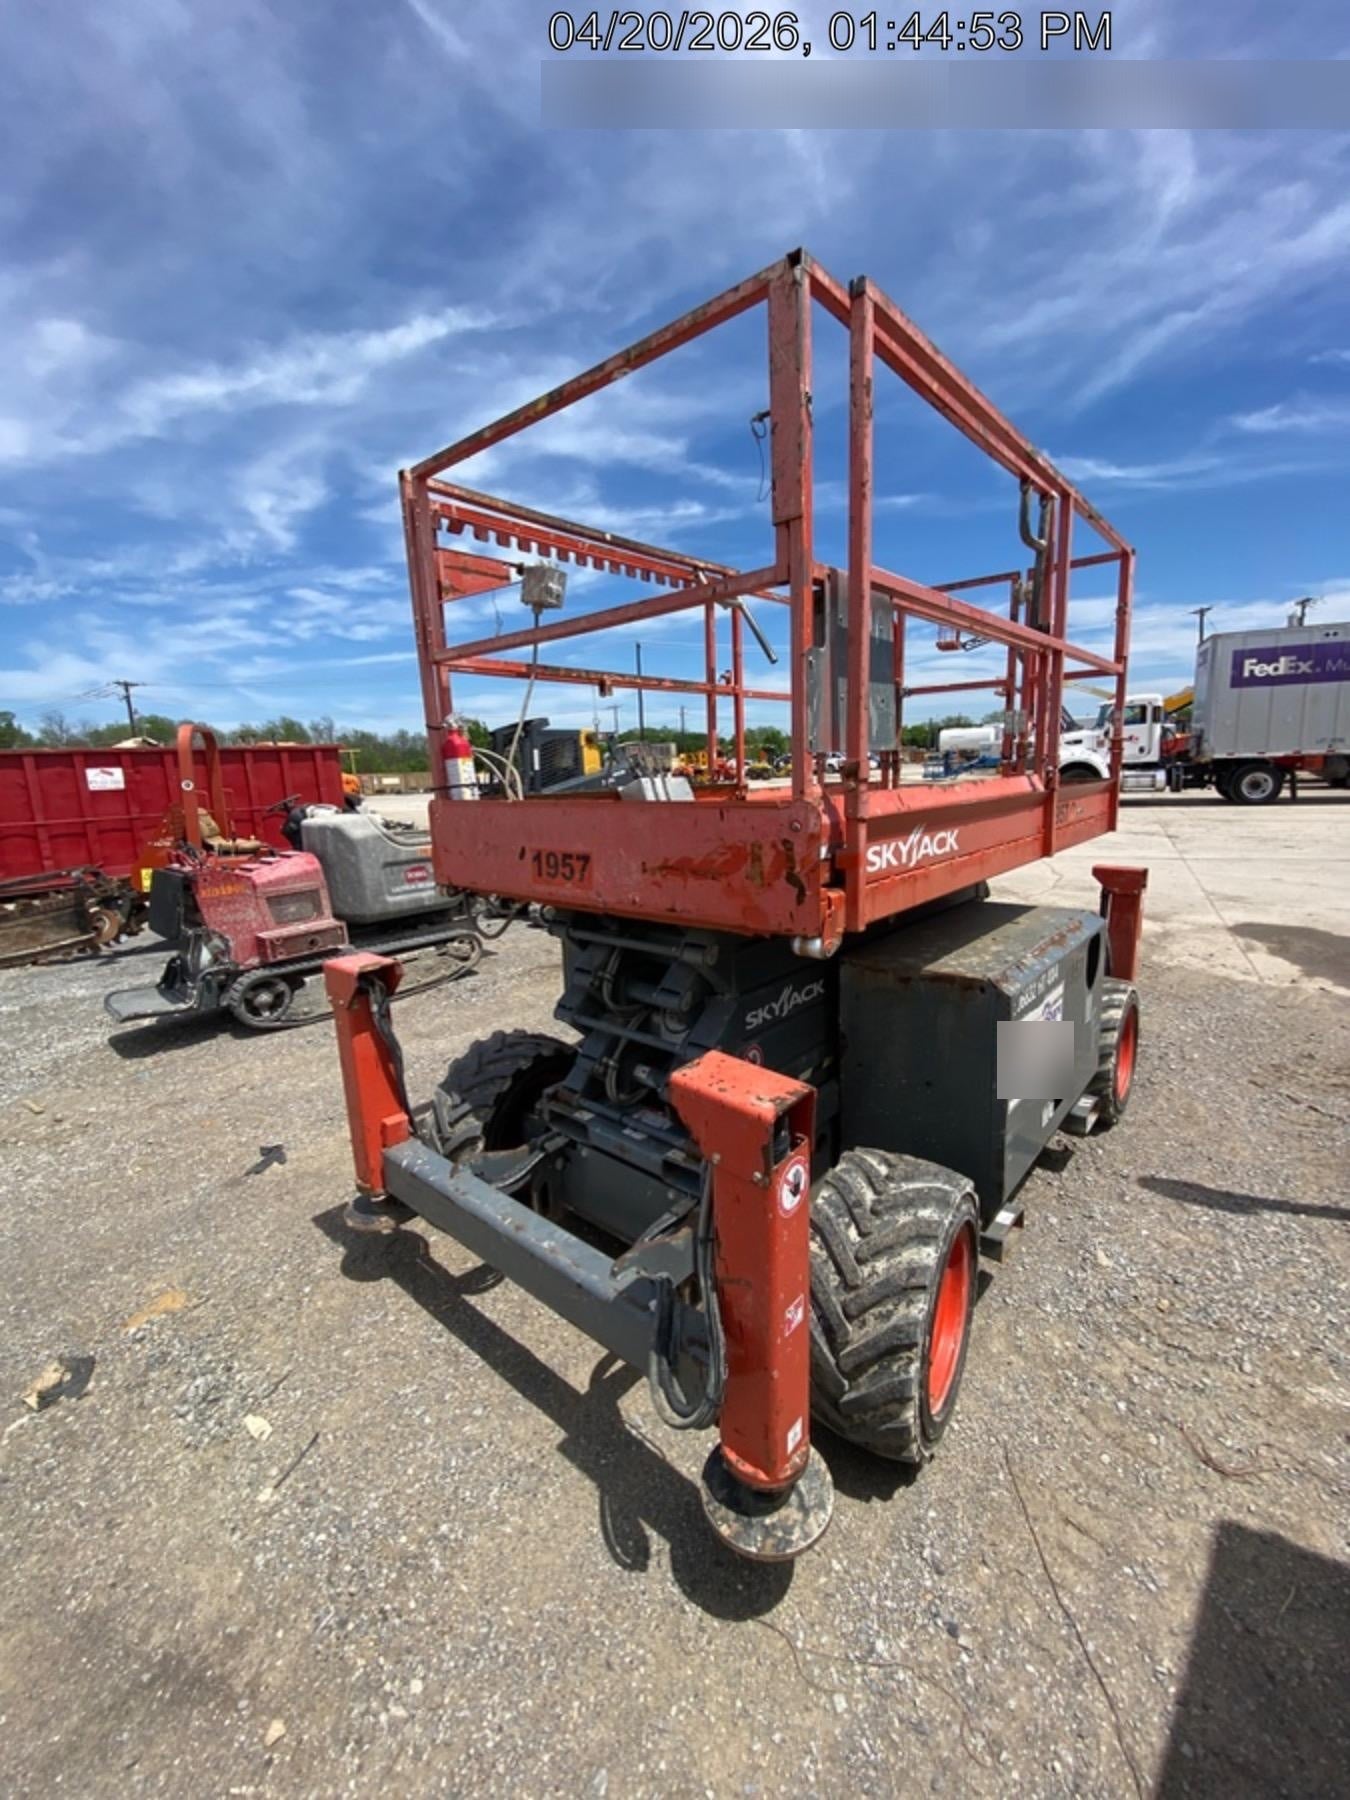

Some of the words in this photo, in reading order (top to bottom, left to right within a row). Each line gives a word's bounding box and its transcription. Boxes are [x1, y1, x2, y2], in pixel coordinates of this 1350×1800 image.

[1243, 655, 1313, 678] FedEx
[532, 850, 591, 883] 1957
[865, 824, 959, 872] SKYJACK
[745, 979, 825, 1031] SKYJACK
